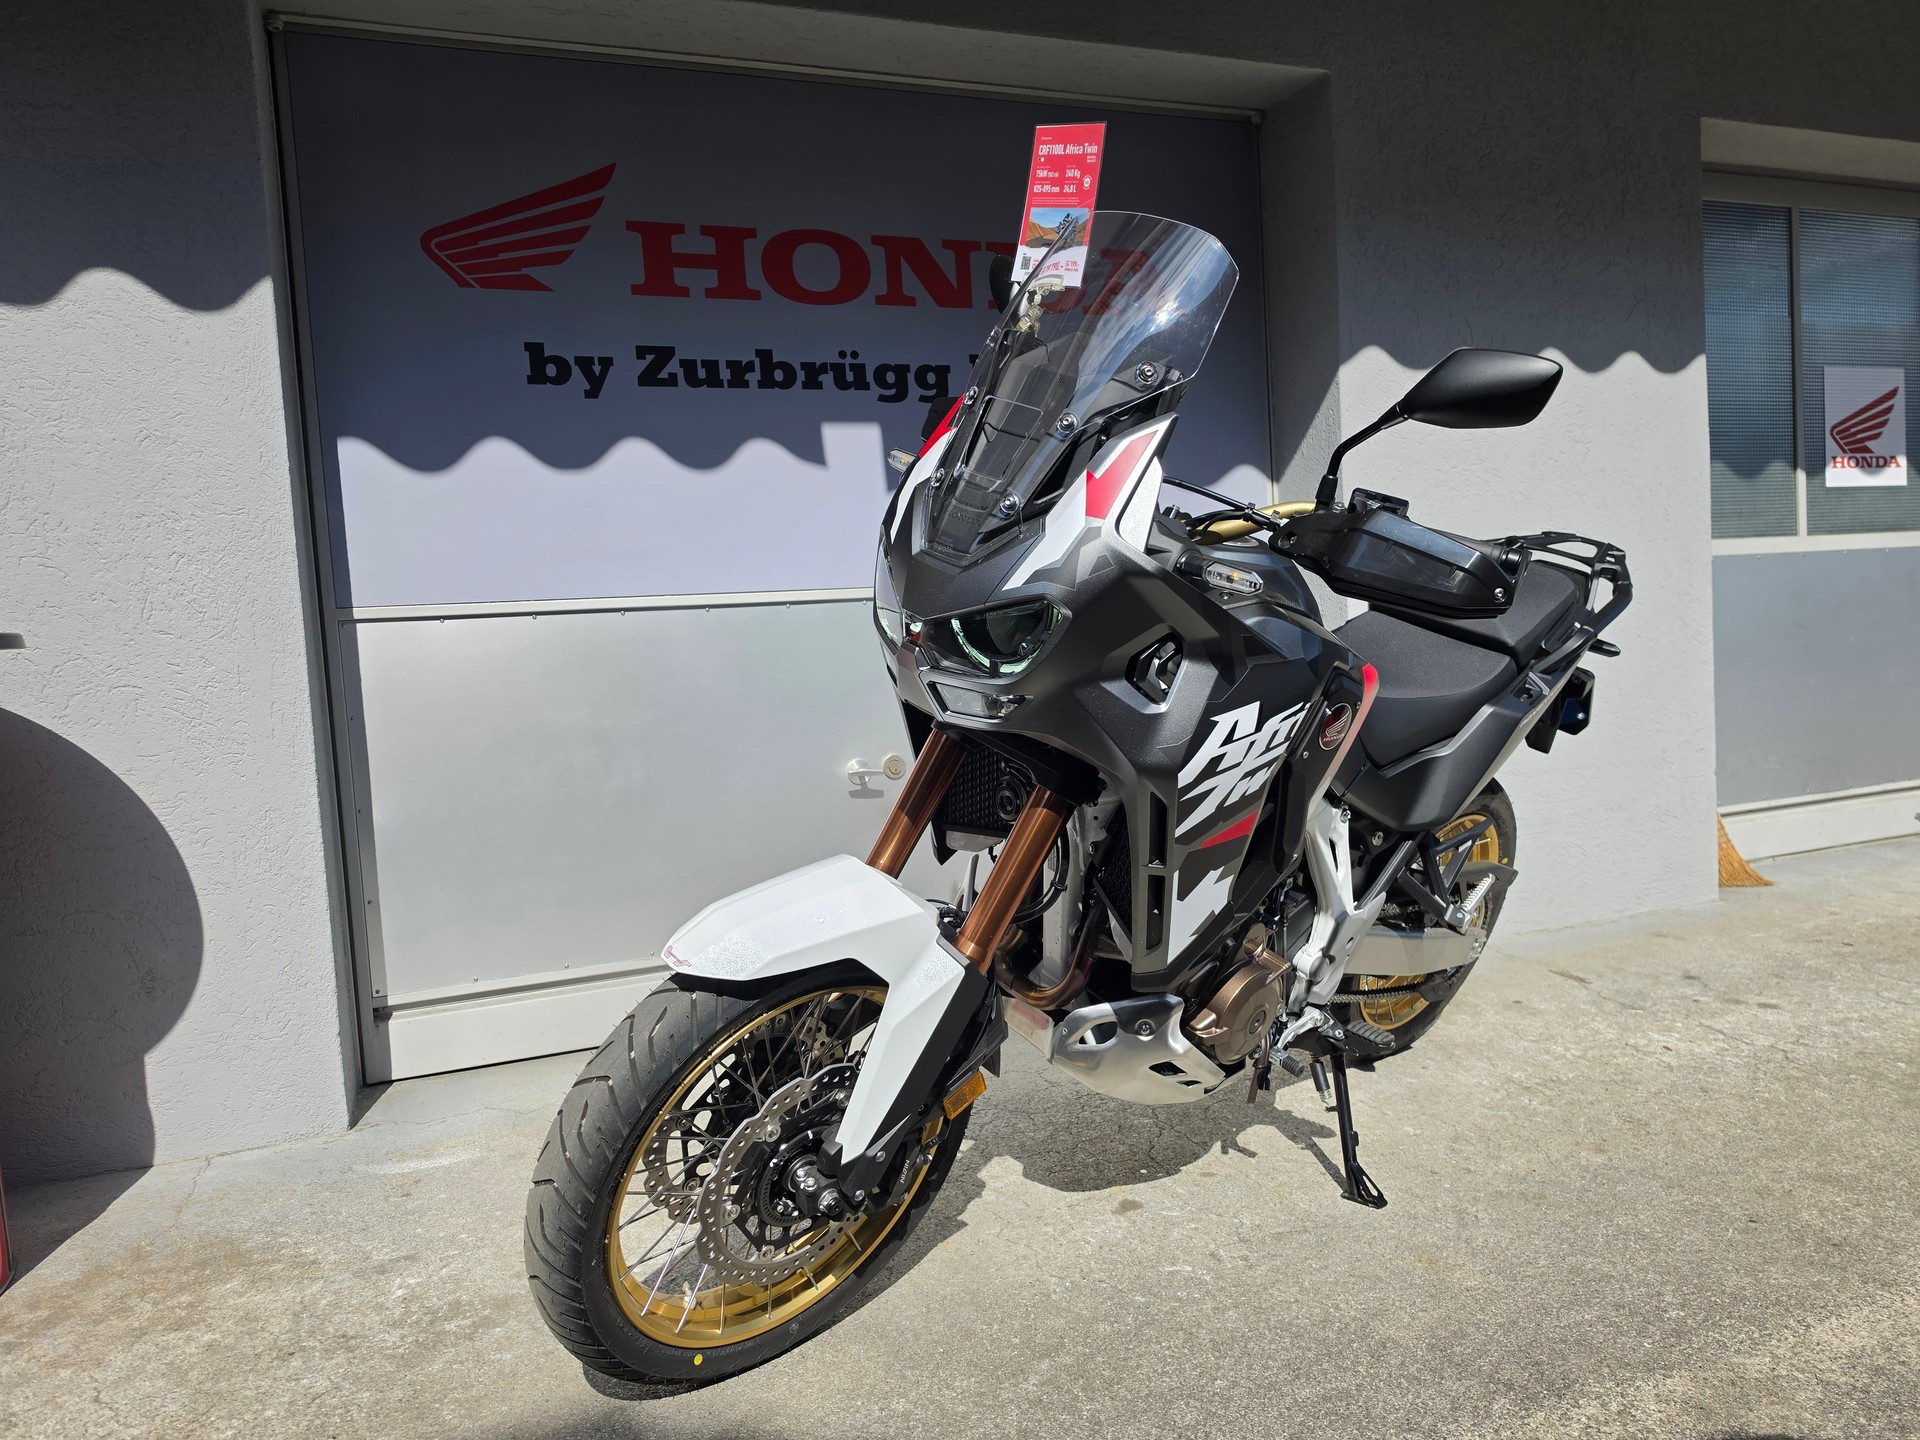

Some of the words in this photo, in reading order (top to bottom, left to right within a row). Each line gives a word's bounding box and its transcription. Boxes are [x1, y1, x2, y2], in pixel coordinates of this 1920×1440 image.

[1039, 144, 1064, 155] CRF1100L
[1065, 143, 1083, 155] Africa
[1084, 142, 1098, 154] Twin
[523, 341, 614, 399] by
[635, 345, 951, 404] Zurbrügg
[1831, 455, 1902, 469] HONDA
